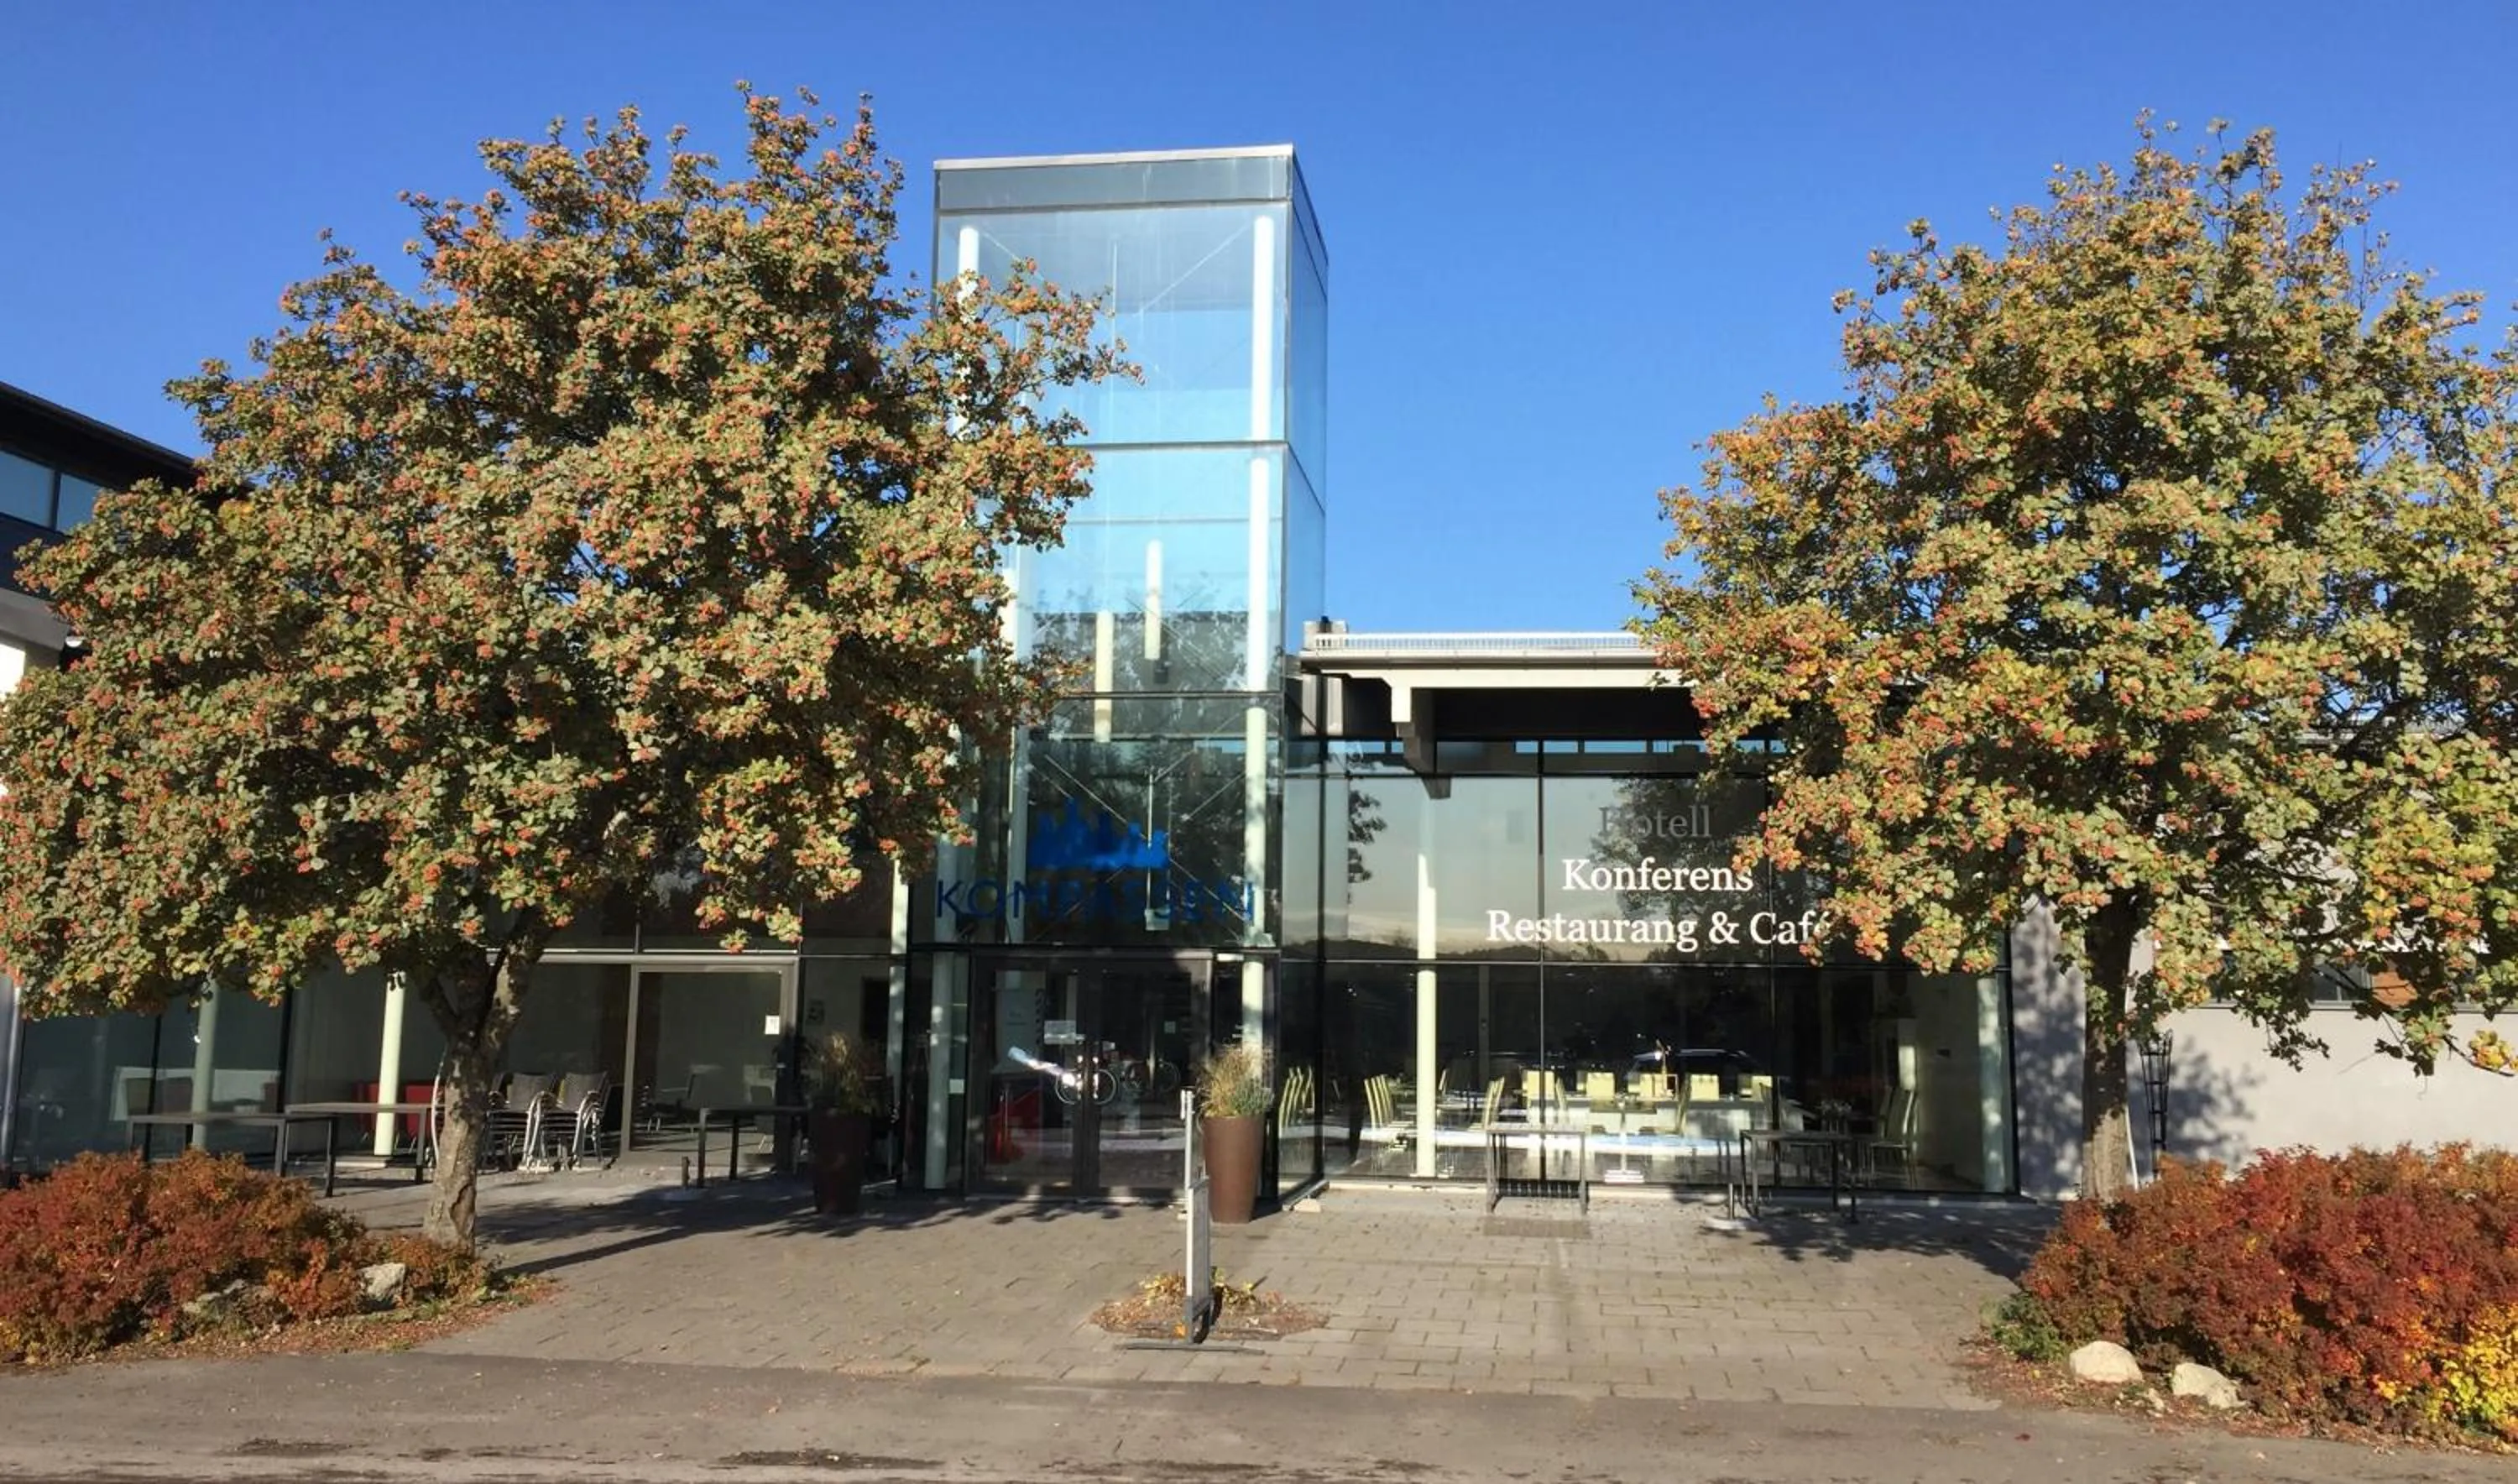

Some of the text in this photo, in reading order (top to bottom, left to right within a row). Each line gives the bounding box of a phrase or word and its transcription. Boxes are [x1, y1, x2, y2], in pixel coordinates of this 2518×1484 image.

[1562, 856, 1754, 891] Konferens
[1486, 910, 1699, 952] Restaurang
[1708, 912, 1741, 944] &
